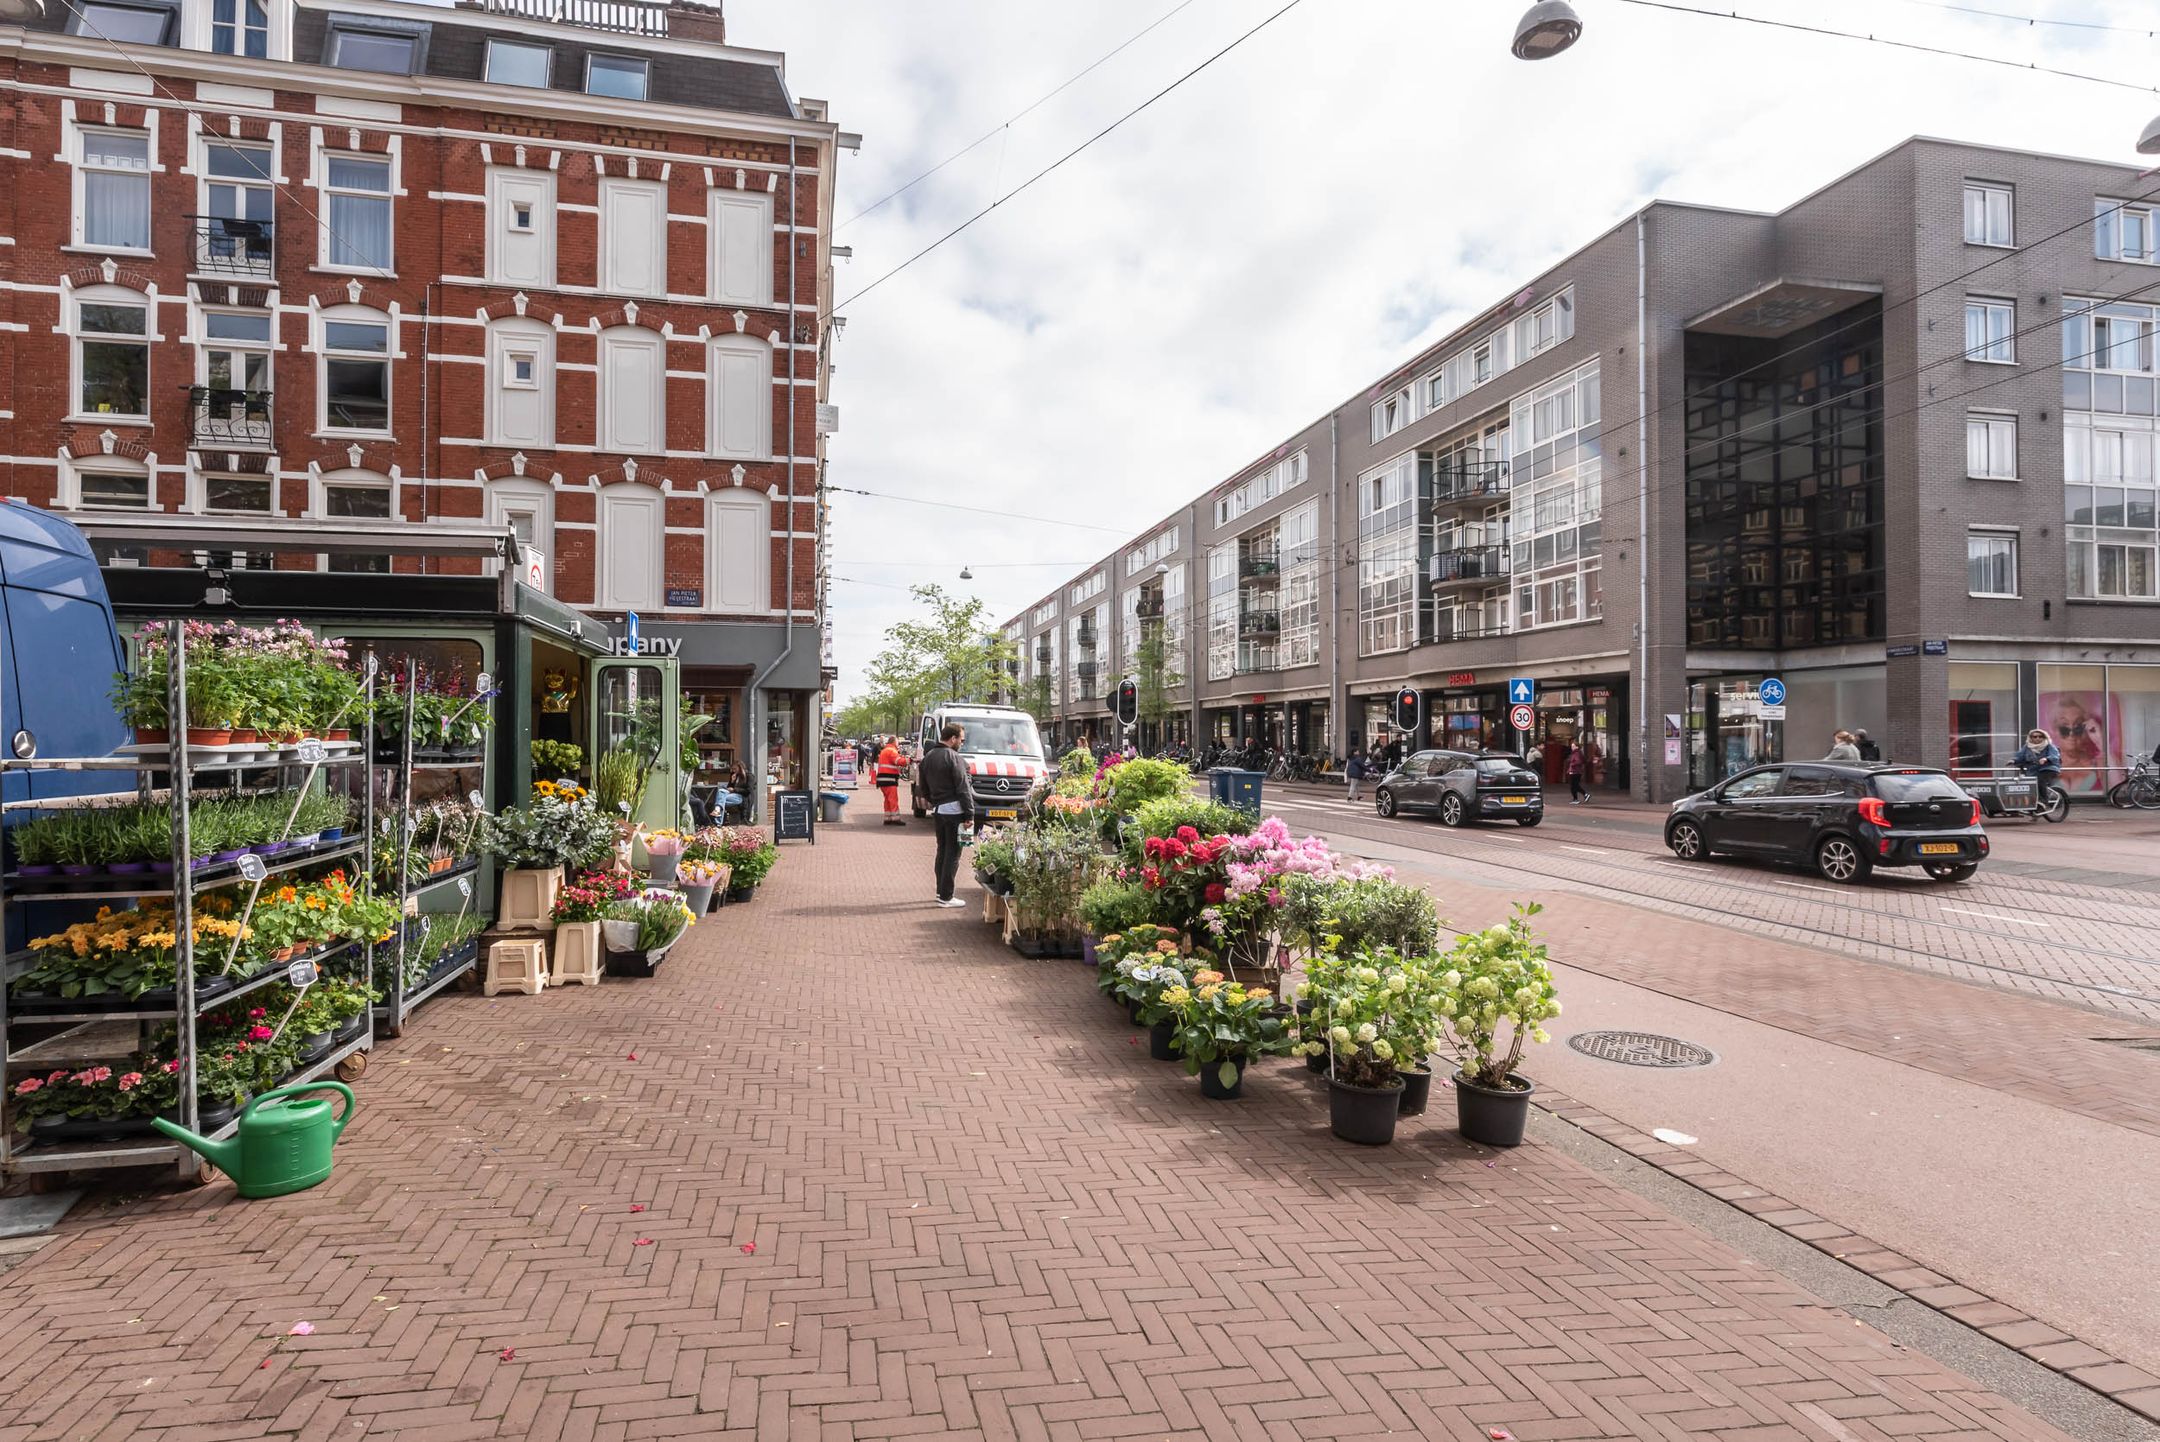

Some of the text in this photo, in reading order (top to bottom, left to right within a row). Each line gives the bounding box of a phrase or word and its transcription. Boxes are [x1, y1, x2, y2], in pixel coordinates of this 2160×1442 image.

[608, 637, 682, 657] pany
[1447, 672, 1475, 688] HEMA
[1515, 713, 1530, 722] 30
